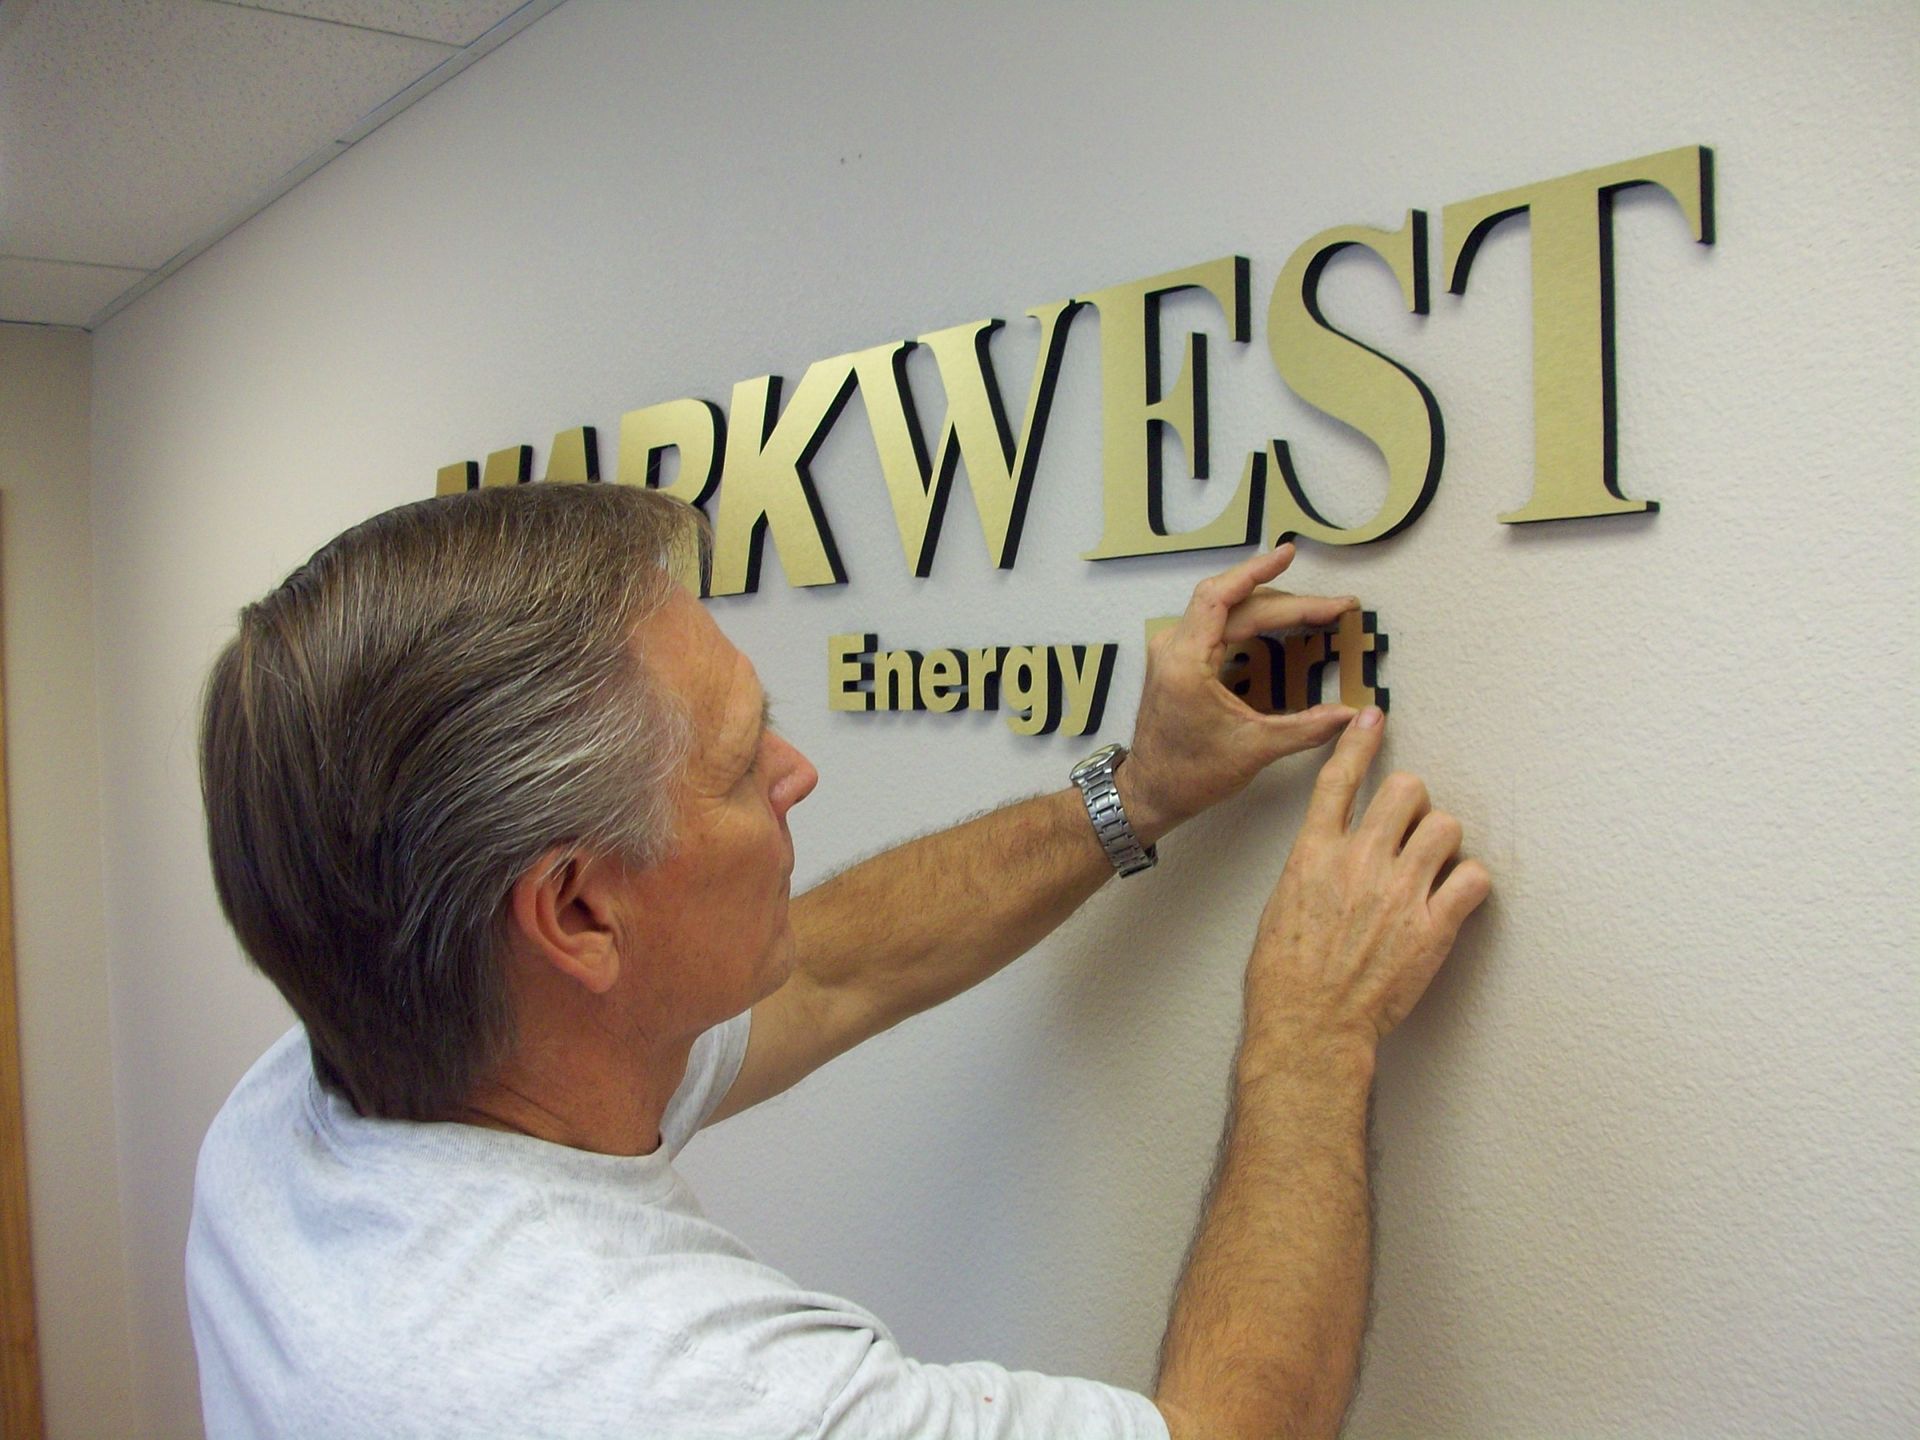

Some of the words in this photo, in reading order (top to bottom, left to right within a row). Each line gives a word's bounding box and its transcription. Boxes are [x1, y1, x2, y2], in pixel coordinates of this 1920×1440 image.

[435, 145, 1717, 598] RKWEST
[828, 633, 1118, 736] Energy
[1145, 611, 1390, 713] art
